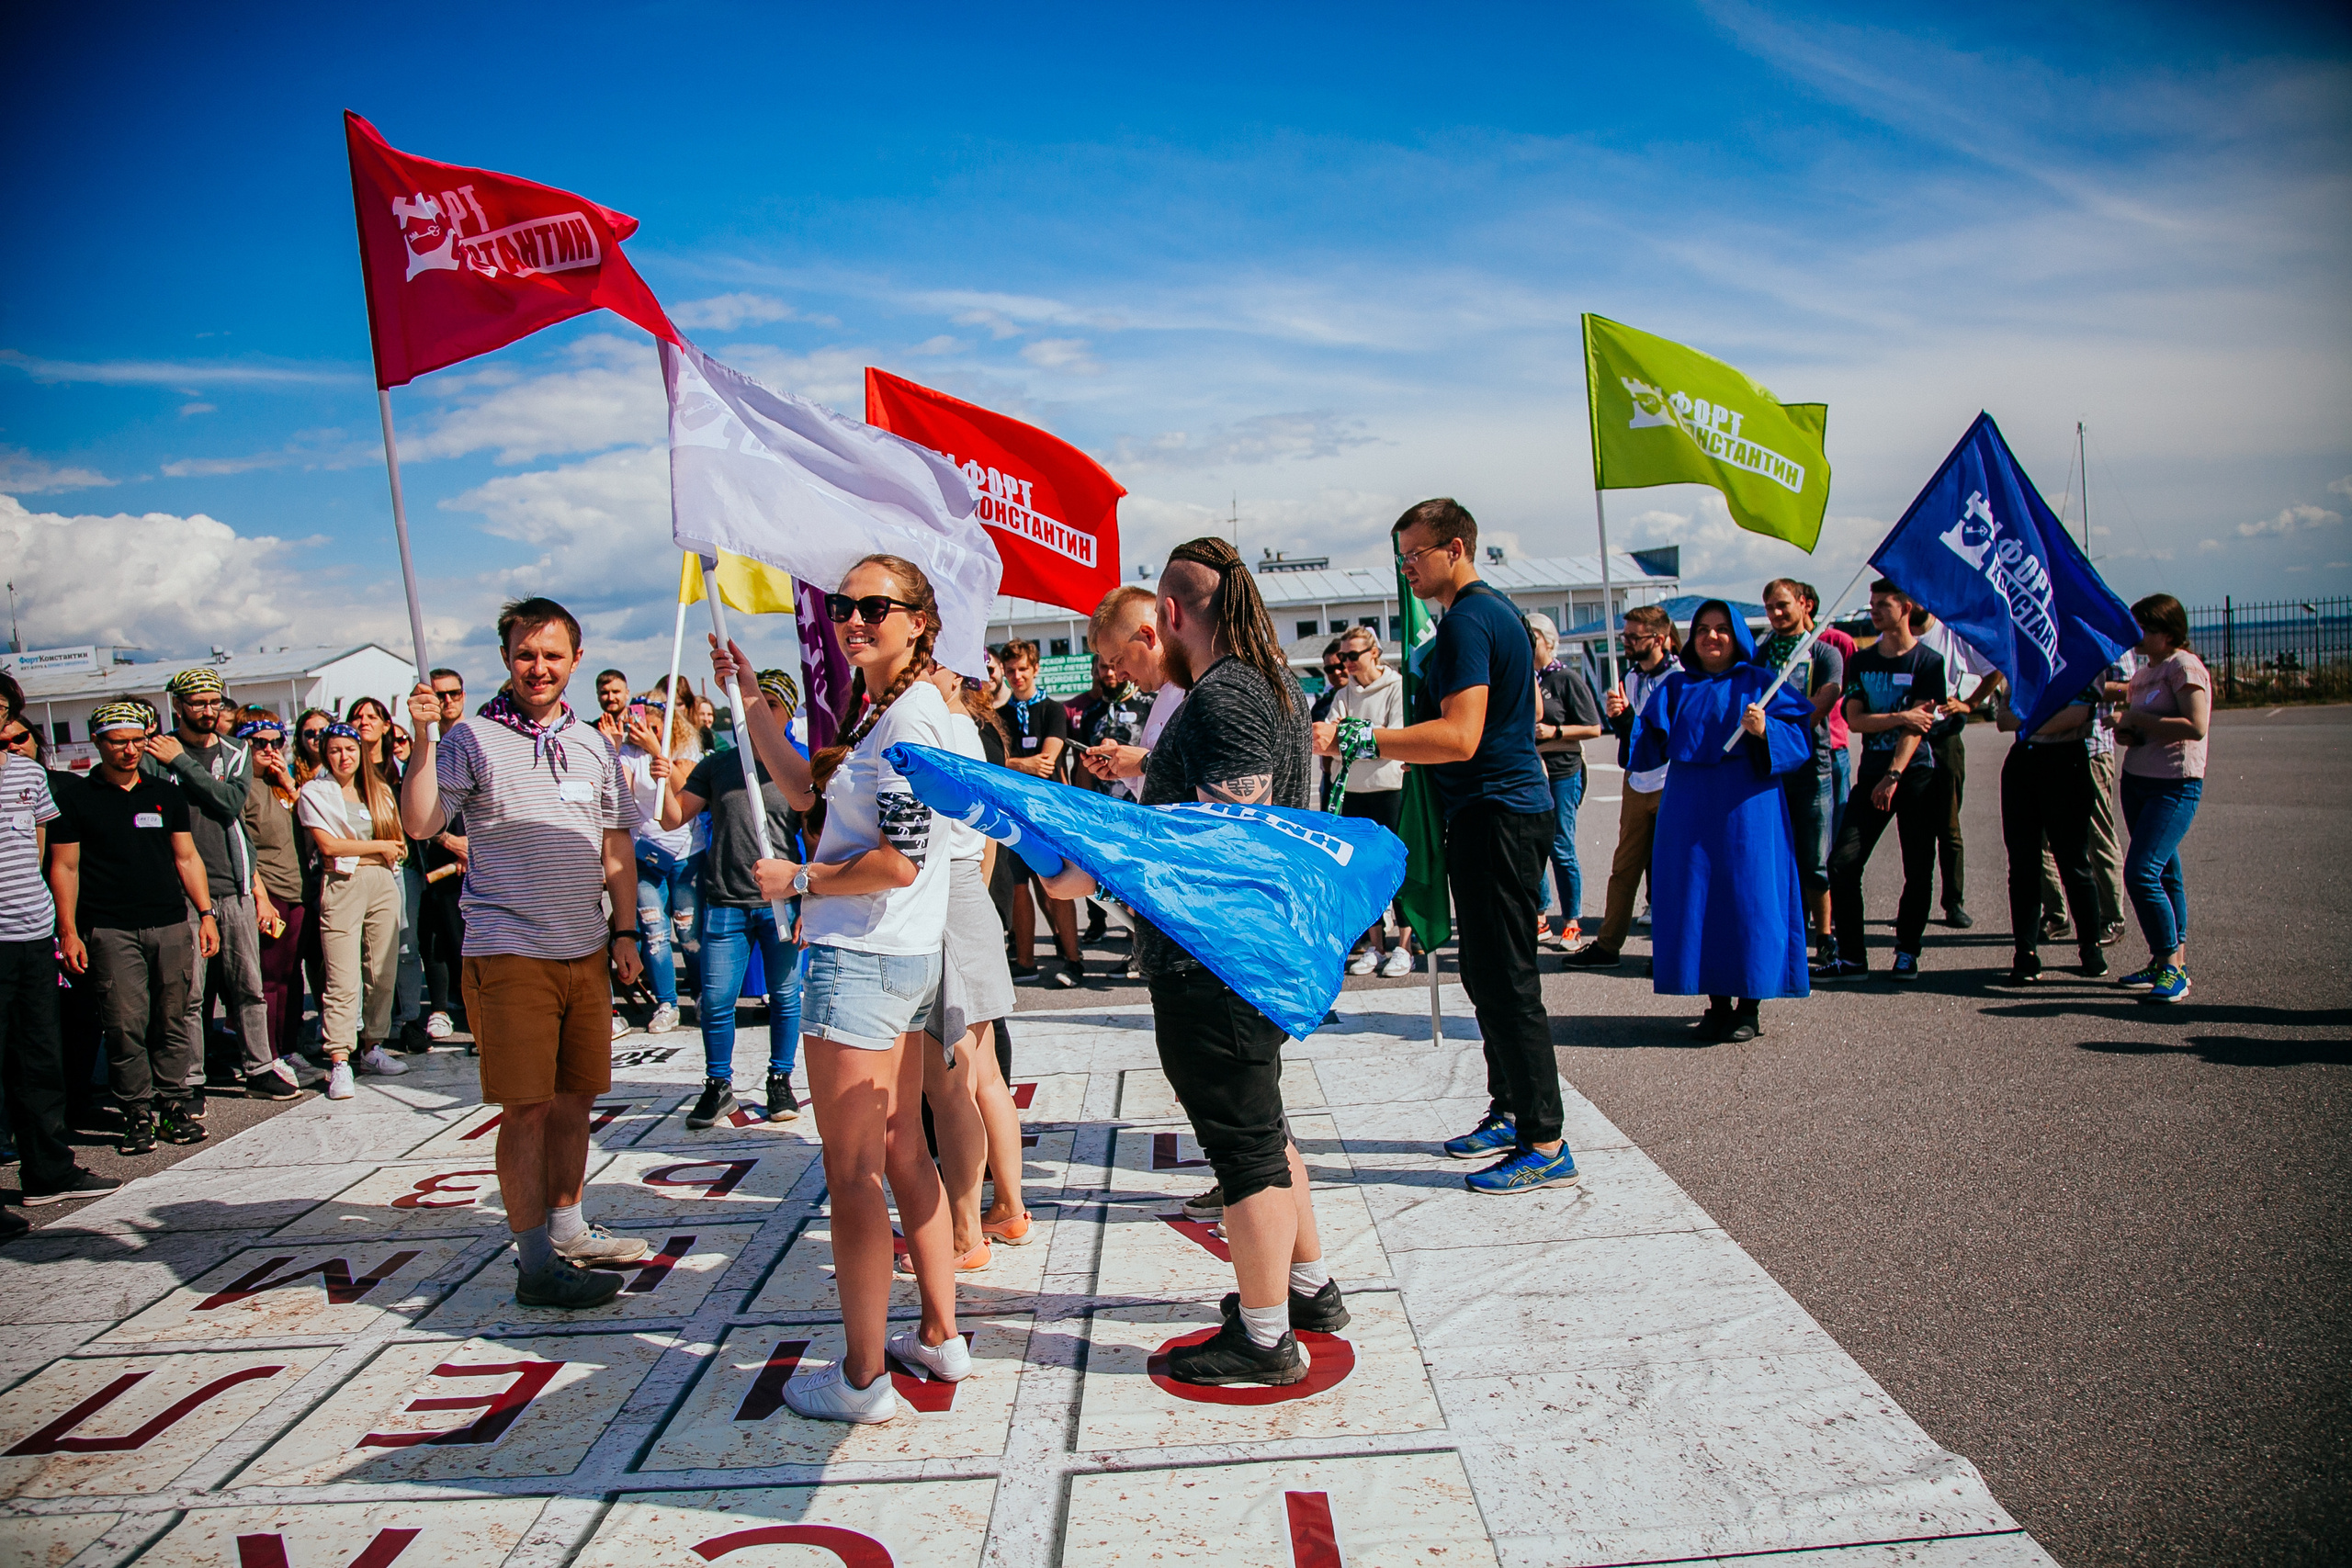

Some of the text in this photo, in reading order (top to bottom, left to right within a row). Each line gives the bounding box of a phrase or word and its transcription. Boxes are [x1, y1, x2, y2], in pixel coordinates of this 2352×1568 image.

[1668, 390, 1744, 436] ФОРТ
[961, 458, 1034, 510] ФОРТ
[975, 495, 1091, 563] ОНСТАНТИН
